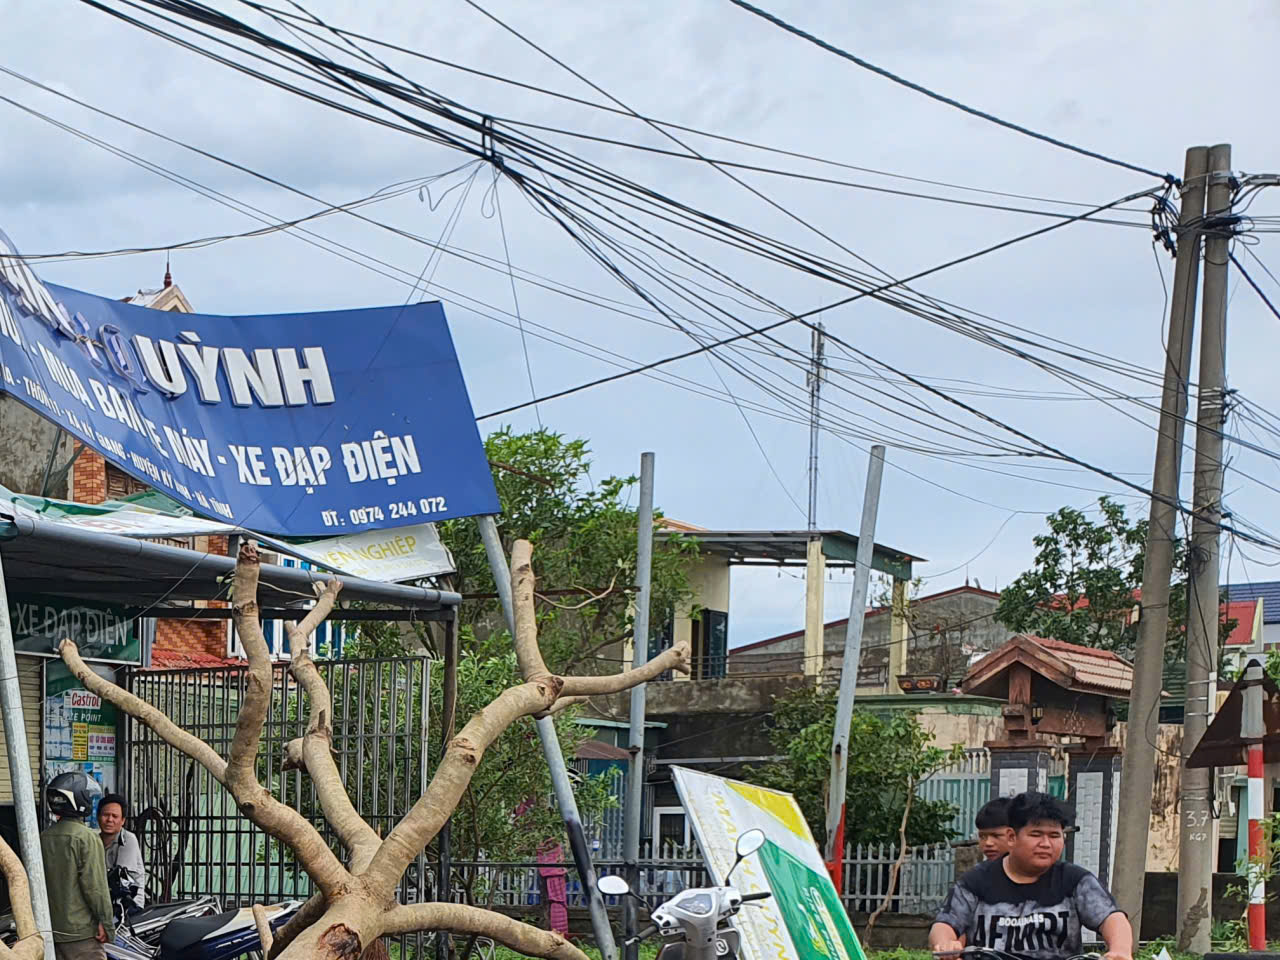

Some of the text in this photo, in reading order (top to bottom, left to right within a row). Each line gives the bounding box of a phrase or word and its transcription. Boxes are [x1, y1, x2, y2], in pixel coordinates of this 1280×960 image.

[36, 340, 97, 413] MUA
[162, 427, 216, 478] MÁY
[228, 444, 273, 486] XE
[271, 446, 332, 495] ĐẠP
[340, 430, 422, 486] ĐIỆN
[350, 507, 385, 526] 0974
[389, 503, 418, 520] 244
[419, 497, 448, 514] 072
[15, 602, 40, 637] XE
[85, 607, 129, 654] ĐIỆN
[71, 692, 100, 708] Castrol
[1185, 810, 1209, 828] 3.7
